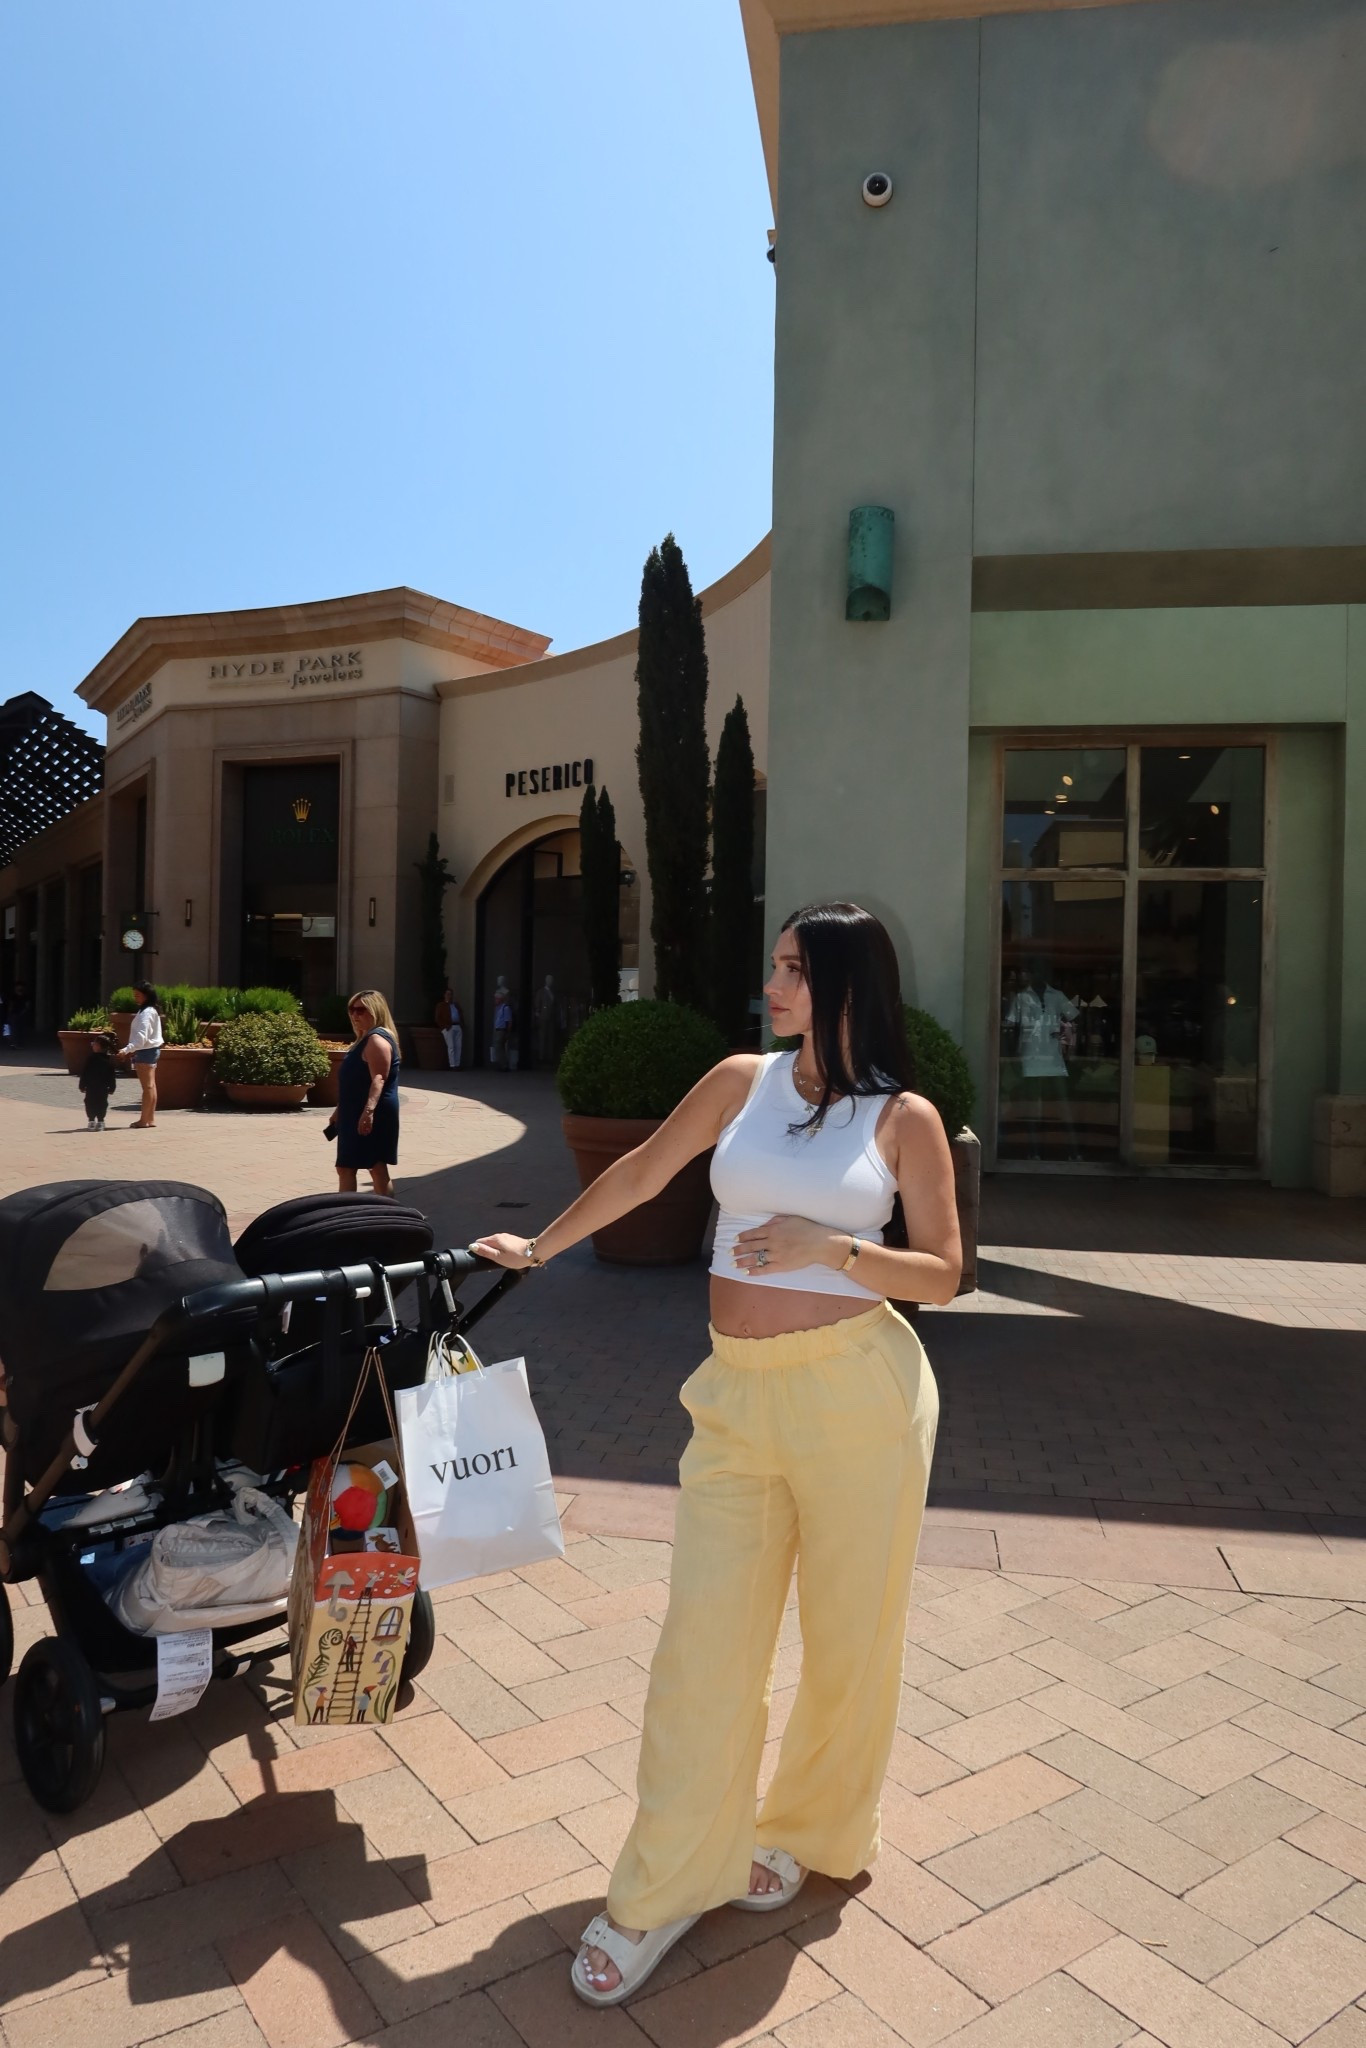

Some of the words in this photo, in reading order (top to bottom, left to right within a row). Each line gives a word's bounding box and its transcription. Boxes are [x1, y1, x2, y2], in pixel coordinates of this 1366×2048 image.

[208, 660, 285, 680] HYDE
[296, 651, 362, 673] PARK
[290, 668, 364, 690] Jewelers
[505, 758, 594, 798] PESERICO
